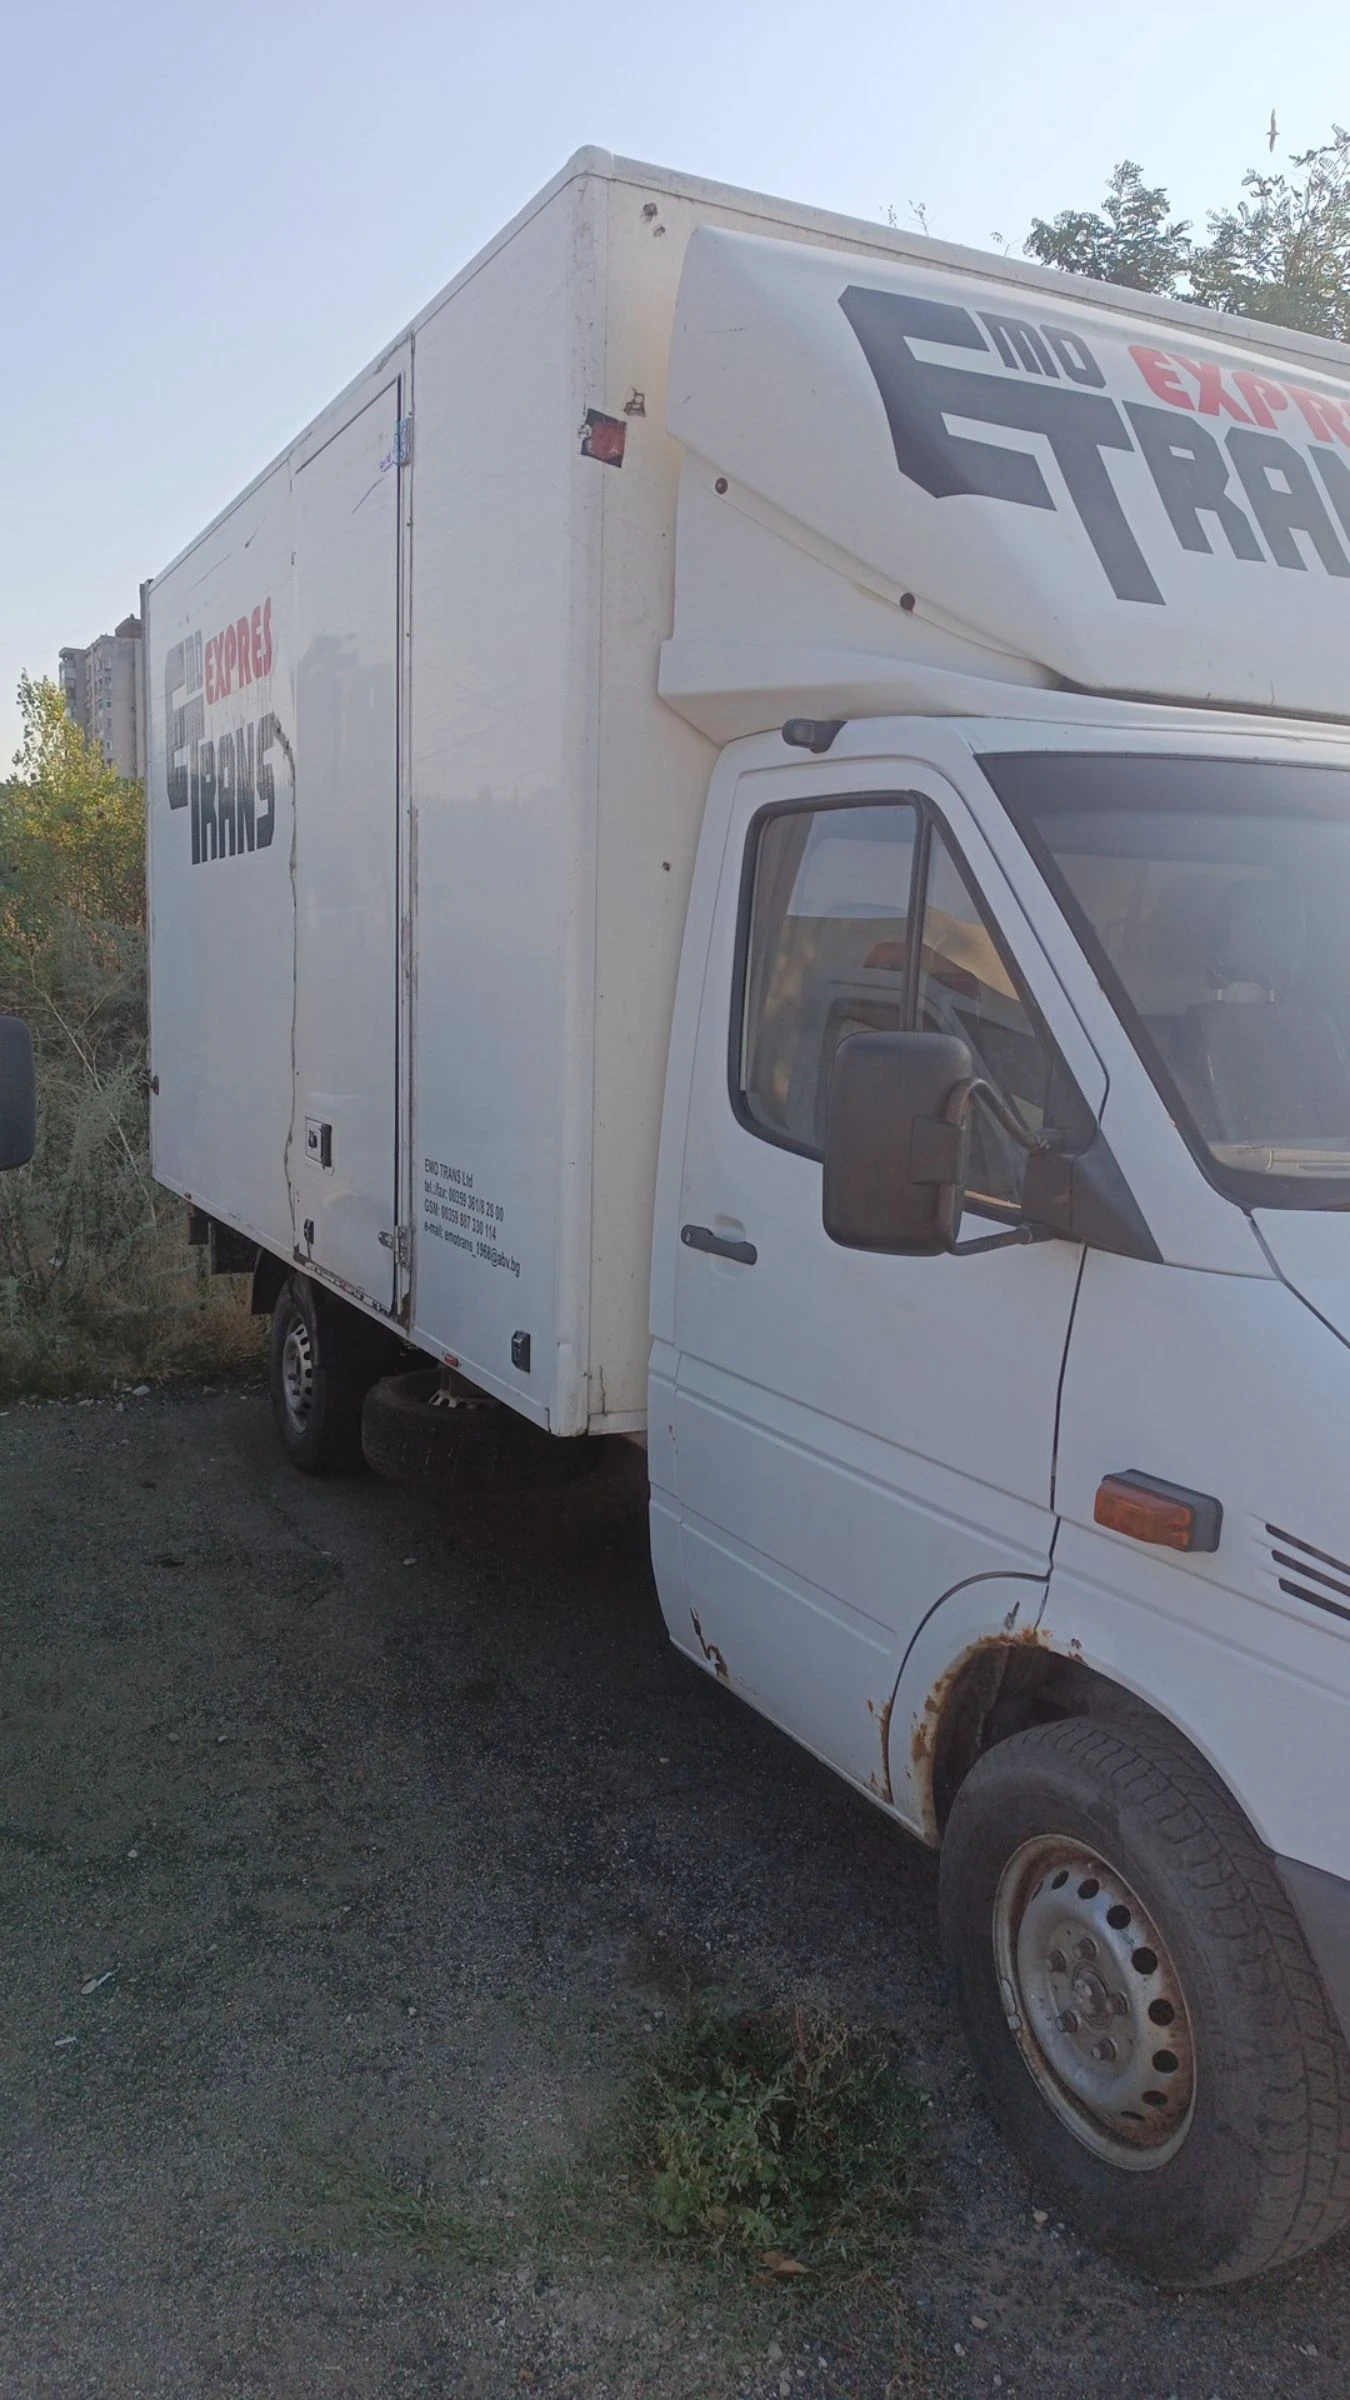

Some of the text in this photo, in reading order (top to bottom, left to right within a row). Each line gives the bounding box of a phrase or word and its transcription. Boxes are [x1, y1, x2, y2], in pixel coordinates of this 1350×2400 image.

[1127, 345, 1350, 447] EXPR
[204, 596, 272, 705] EXPRES
[424, 1159, 473, 1188] EMO TRANS Ltd
[424, 1199, 440, 1218] GSM:
[441, 1204, 459, 1225] 00359
[472, 1218, 484, 1236] 330
[485, 1223, 497, 1241] 114
[449, 1187, 467, 1207] 00359
[495, 1205, 504, 1222] 00
[424, 1221, 444, 1239] e-mail:
